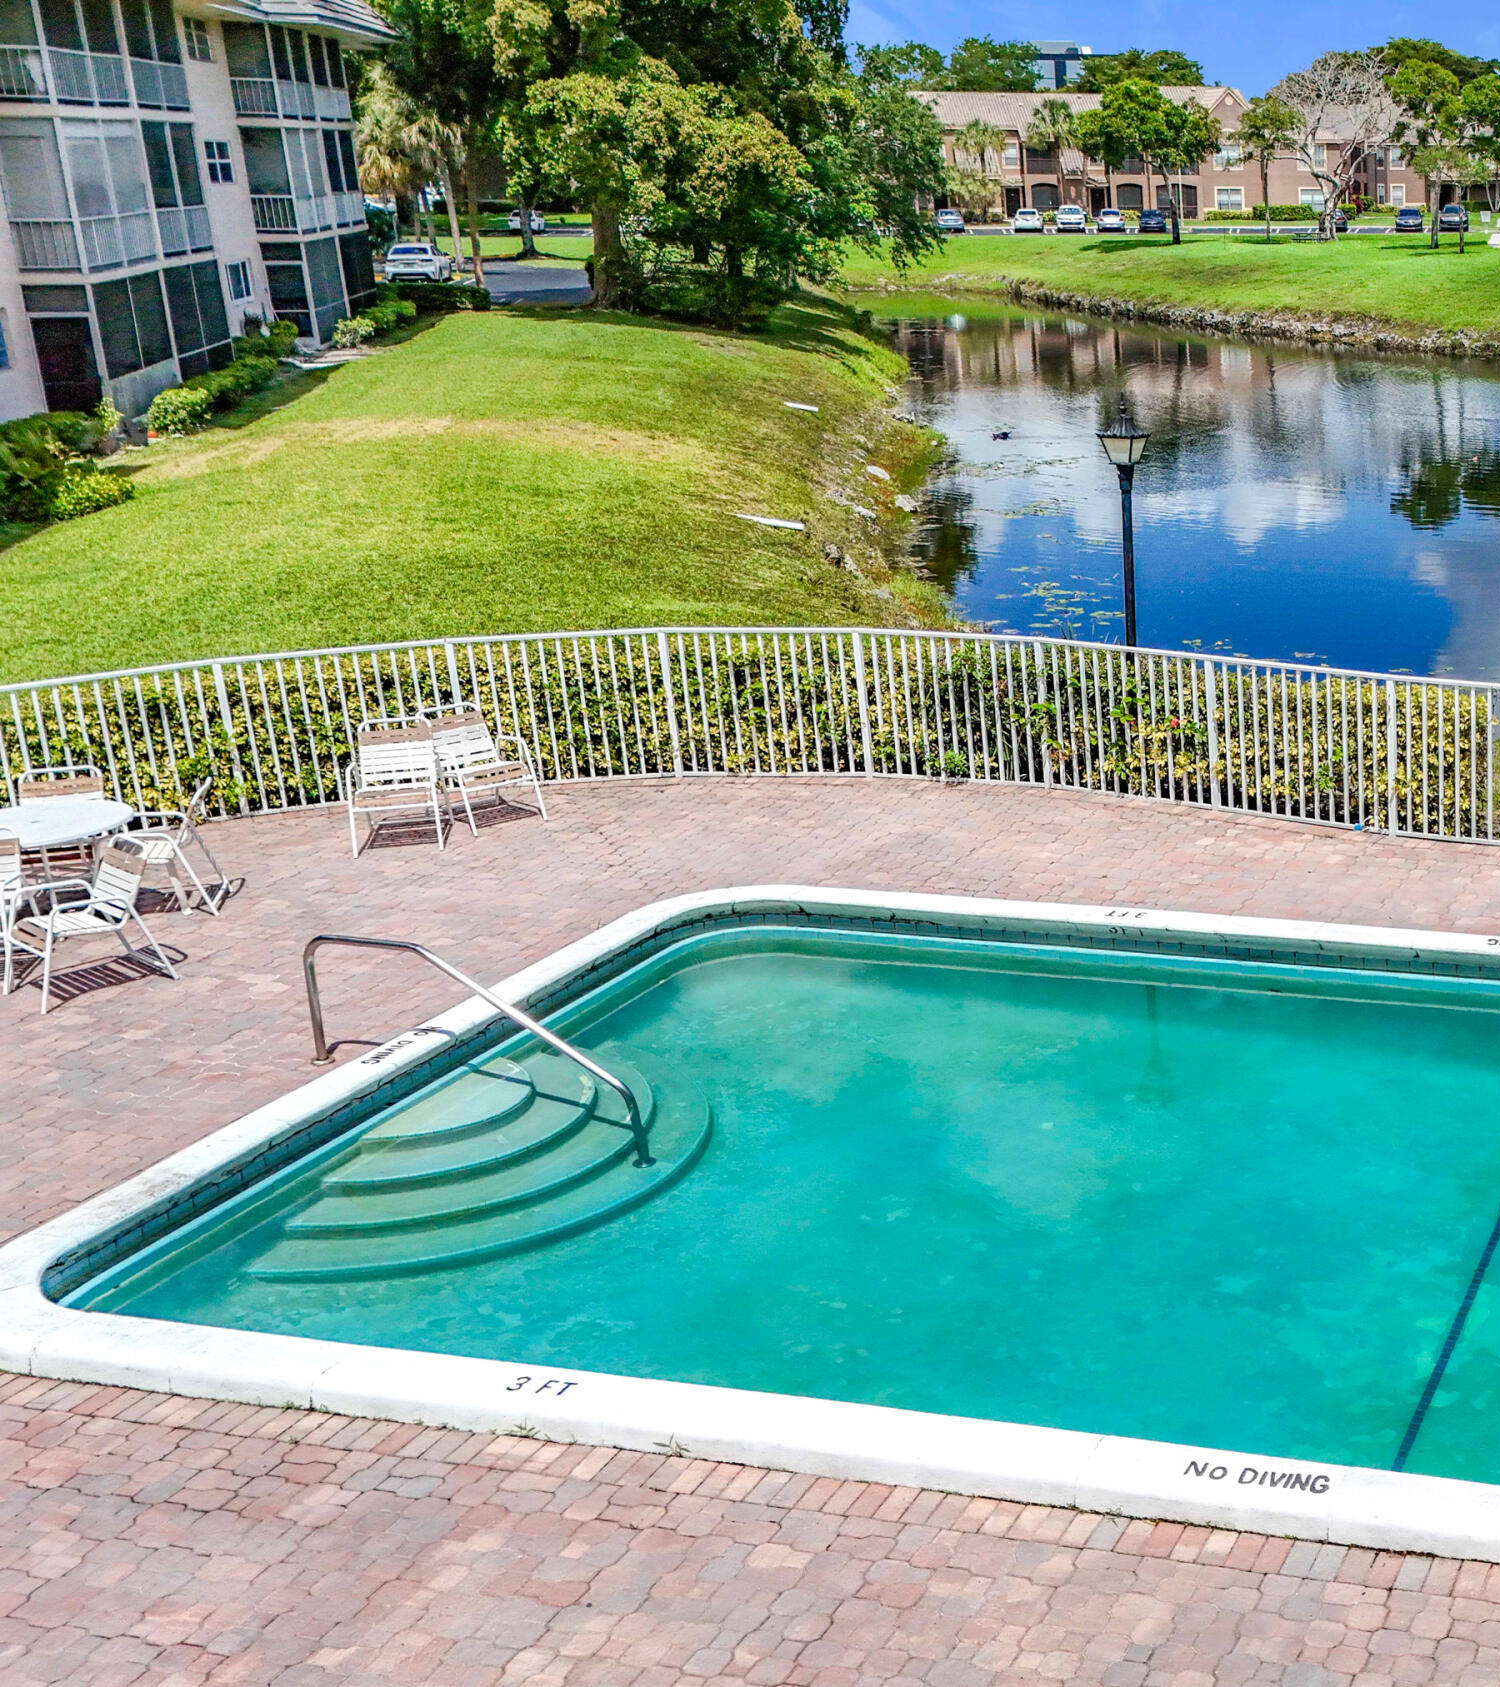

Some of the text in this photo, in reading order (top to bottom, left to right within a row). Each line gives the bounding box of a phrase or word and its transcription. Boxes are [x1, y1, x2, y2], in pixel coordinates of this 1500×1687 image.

[1104, 910, 1130, 918] FT
[360, 1026, 443, 1065] NO DIVING
[505, 1376, 579, 1396] 3 FT
[1183, 1460, 1331, 1495] NO DIVING
